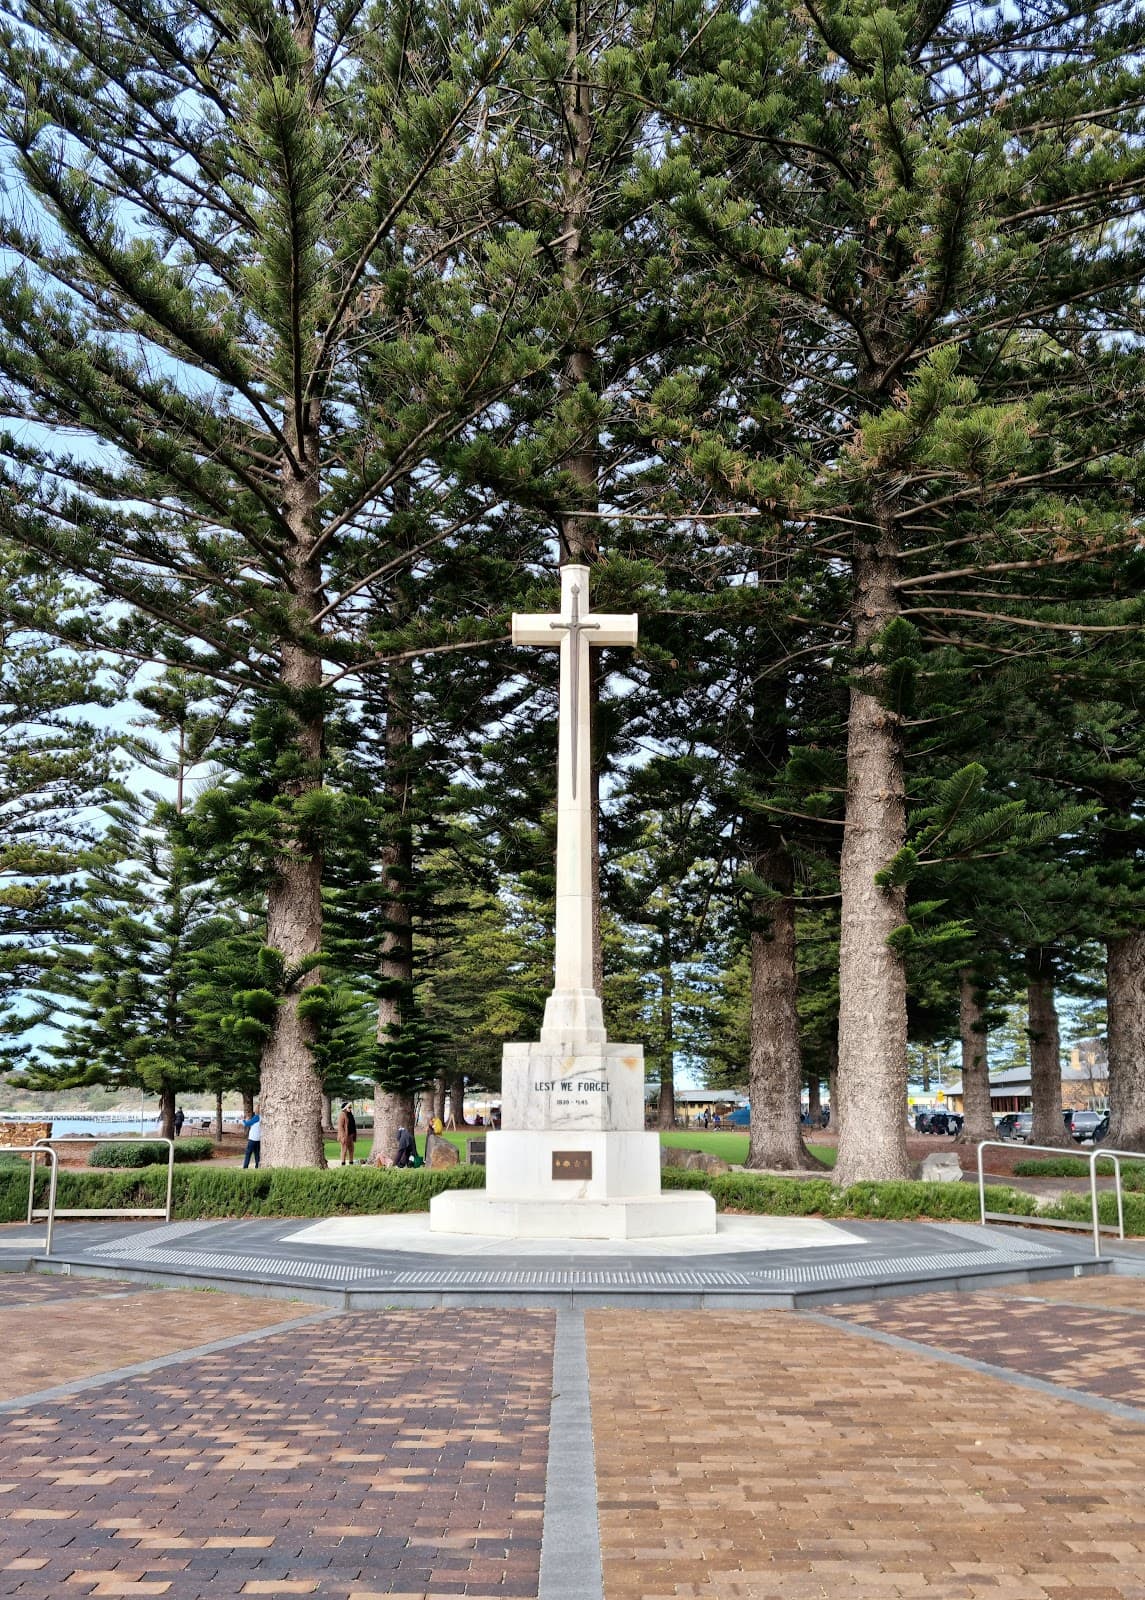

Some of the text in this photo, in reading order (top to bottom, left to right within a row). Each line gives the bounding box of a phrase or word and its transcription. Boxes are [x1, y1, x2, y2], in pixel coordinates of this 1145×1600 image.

[534, 1081, 610, 1092] LEST WE FORGET
